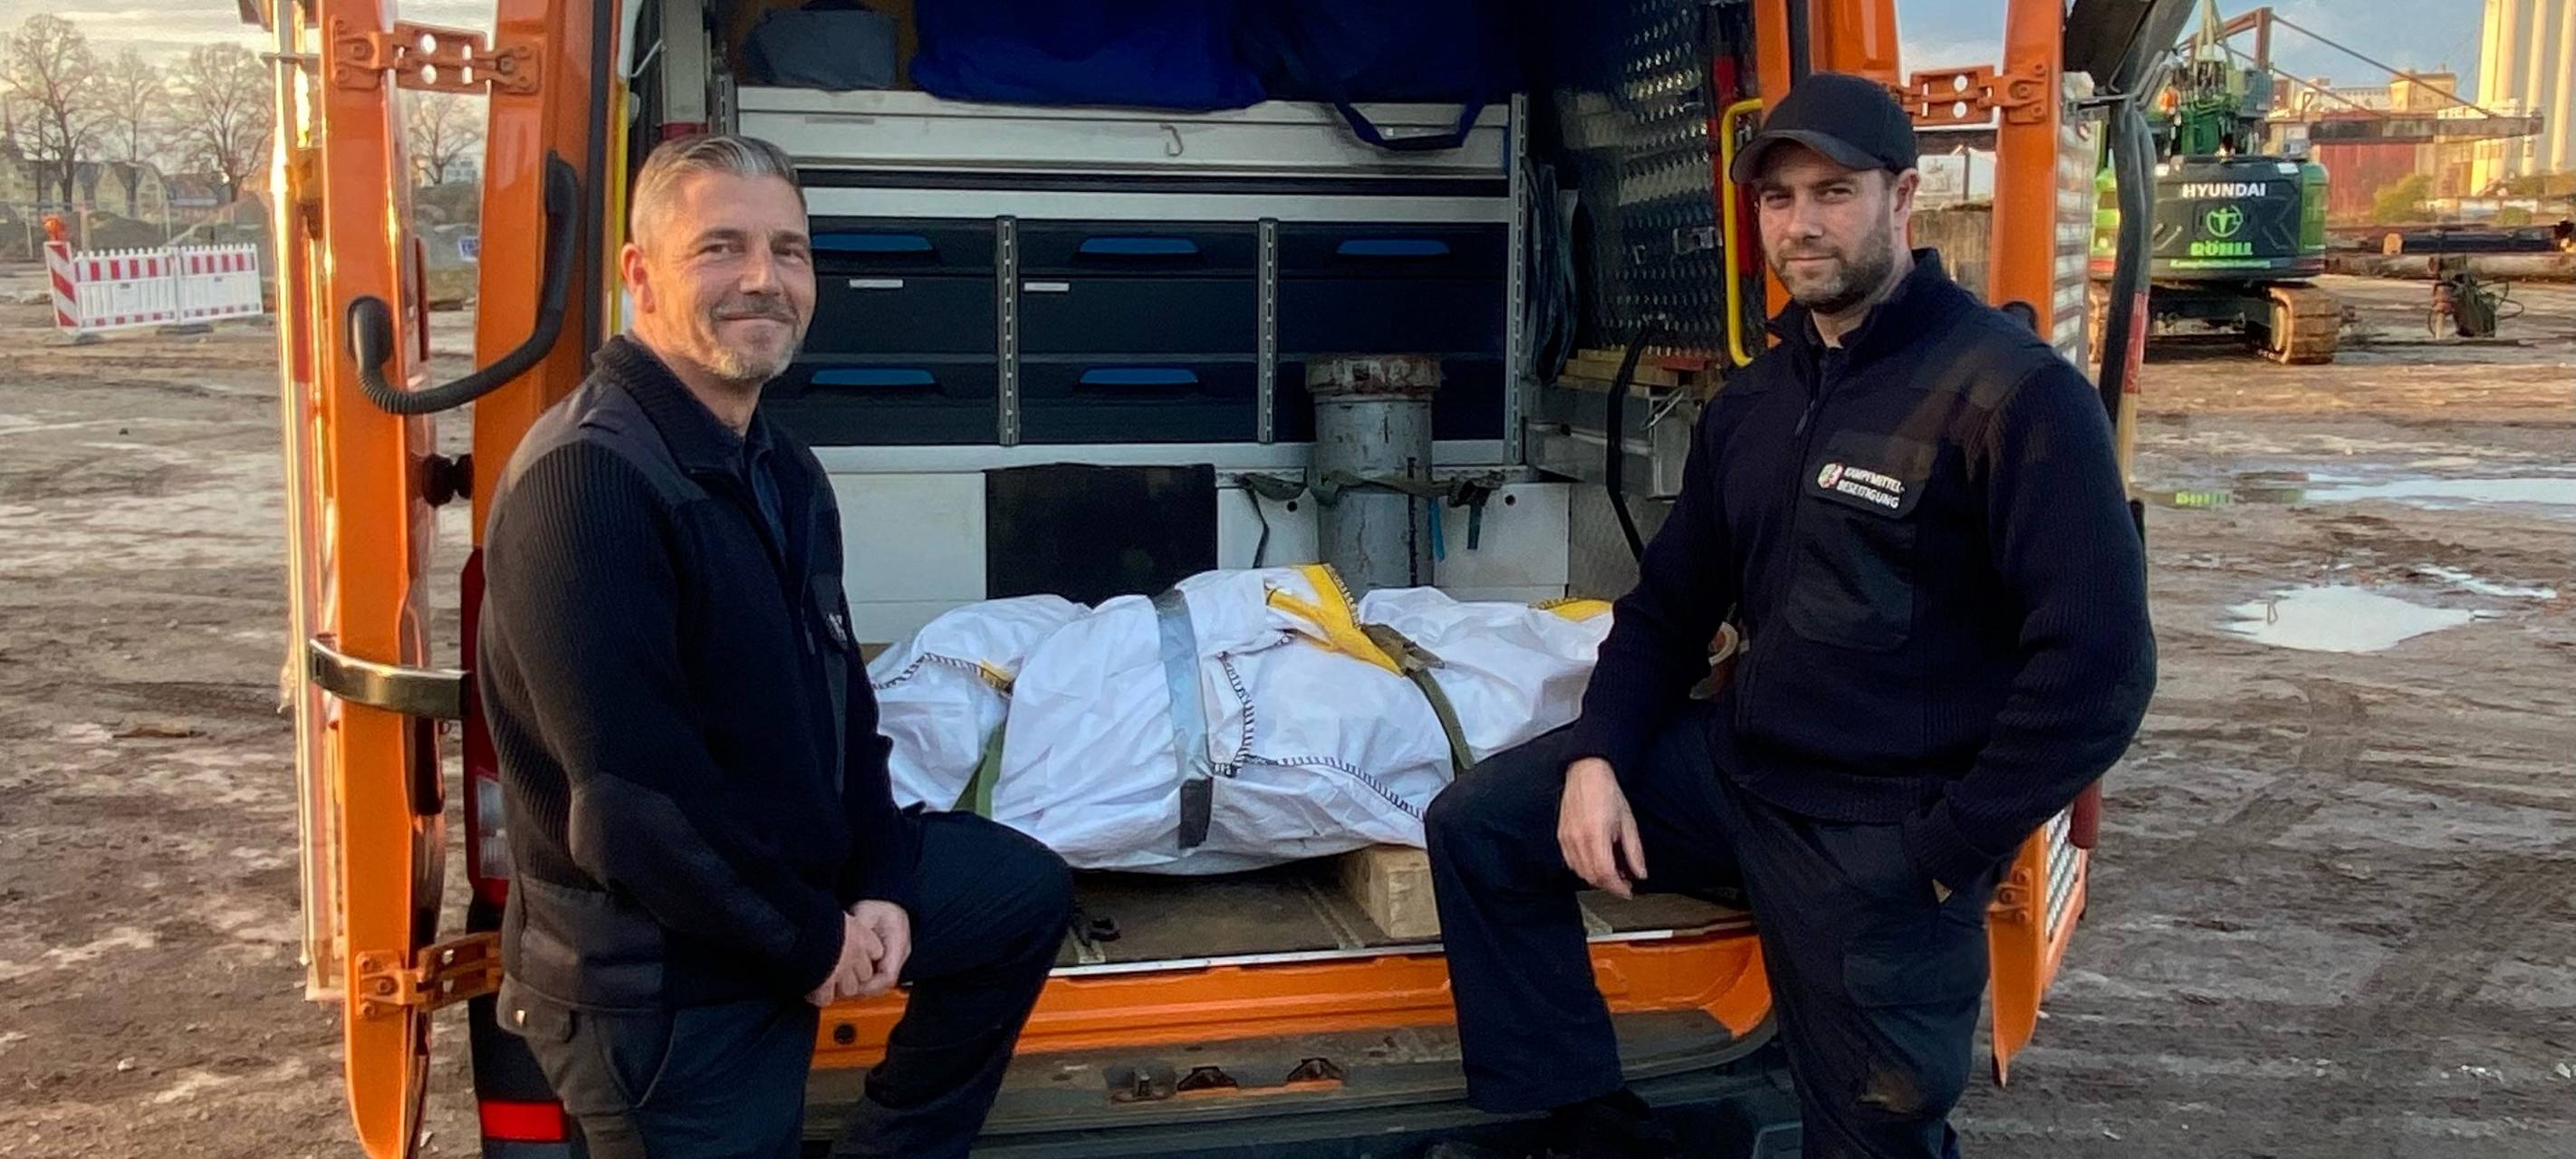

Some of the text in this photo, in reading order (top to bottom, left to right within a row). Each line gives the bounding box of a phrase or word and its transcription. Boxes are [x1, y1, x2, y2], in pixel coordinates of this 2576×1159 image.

[2182, 183, 2266, 197] HYUNDAI
[1843, 466, 1906, 493] KAMPFMITTEL-
[1837, 479, 1899, 508] BESEITIGUNG
